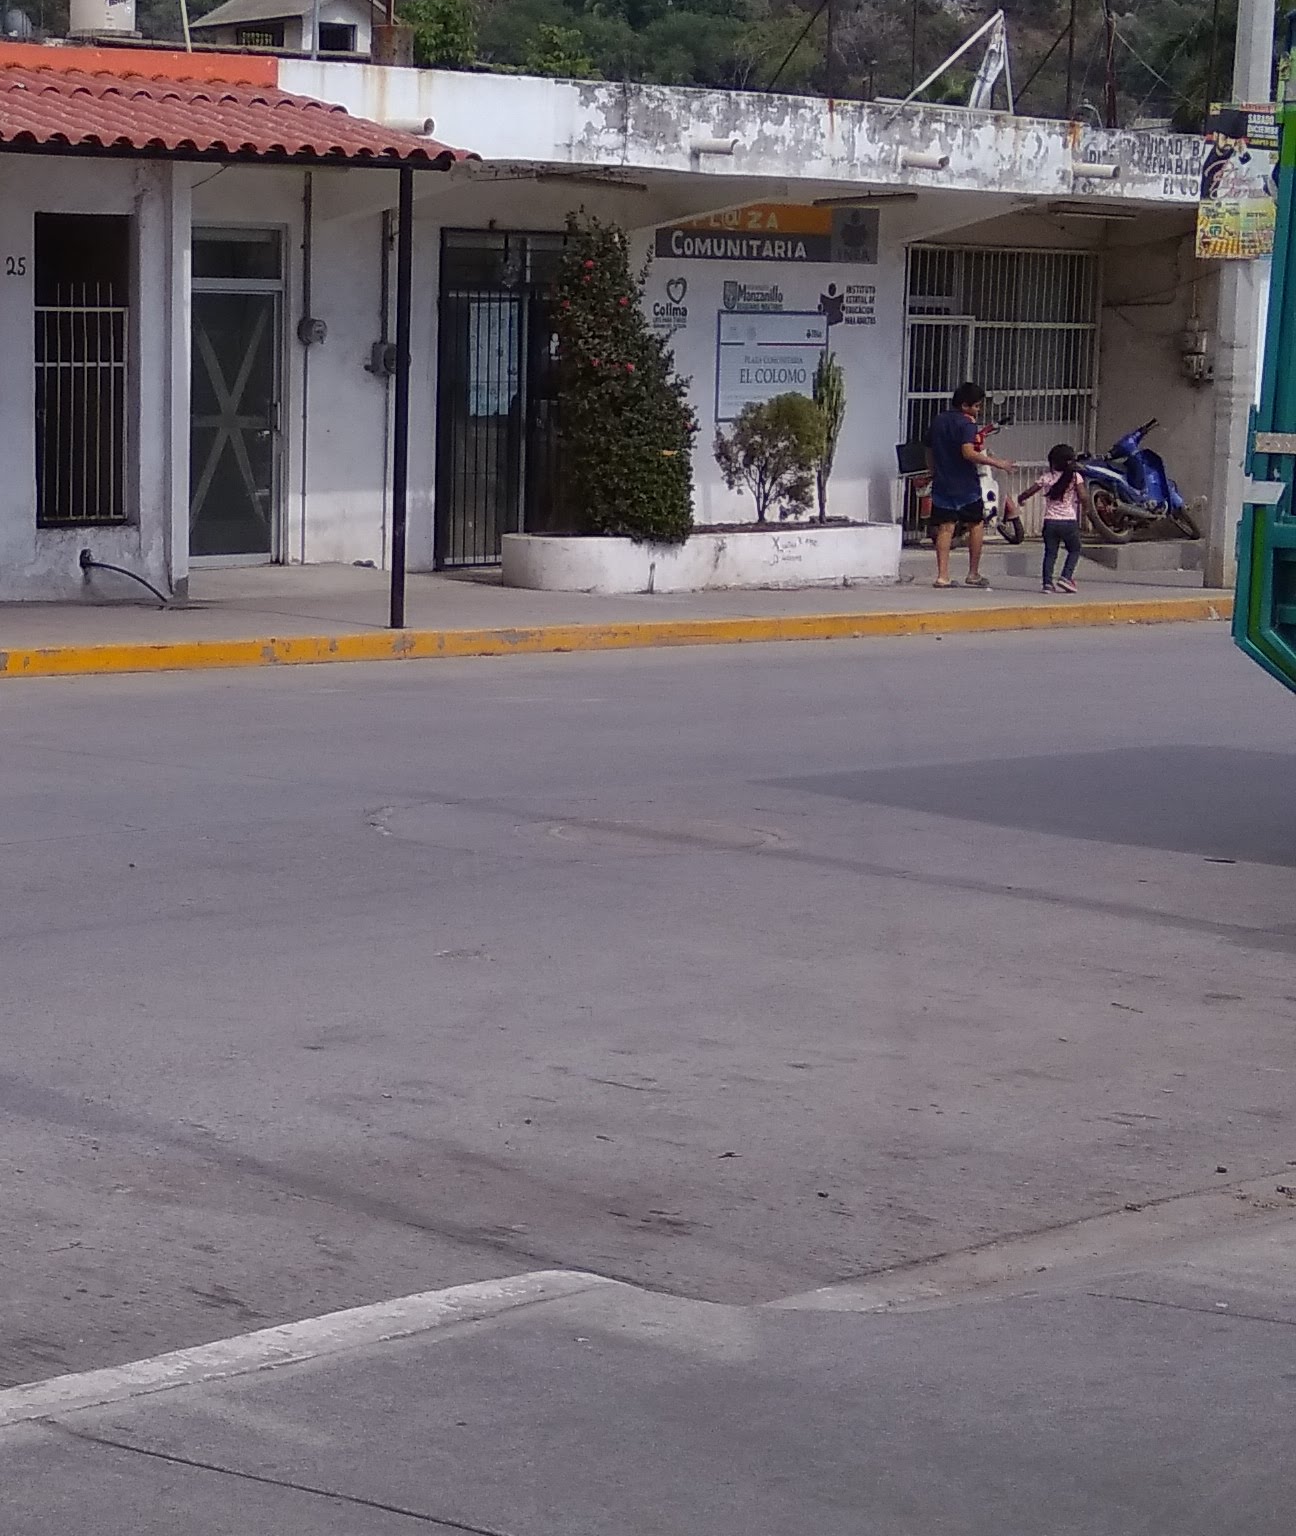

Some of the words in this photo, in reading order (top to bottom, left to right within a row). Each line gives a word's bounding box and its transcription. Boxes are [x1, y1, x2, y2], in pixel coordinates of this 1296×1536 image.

[6, 256, 26, 276] 25
[737, 283, 784, 303] Manzanillo
[653, 302, 688, 317] Colima
[739, 368, 752, 384] EL
[754, 368, 807, 384] COLOMO
